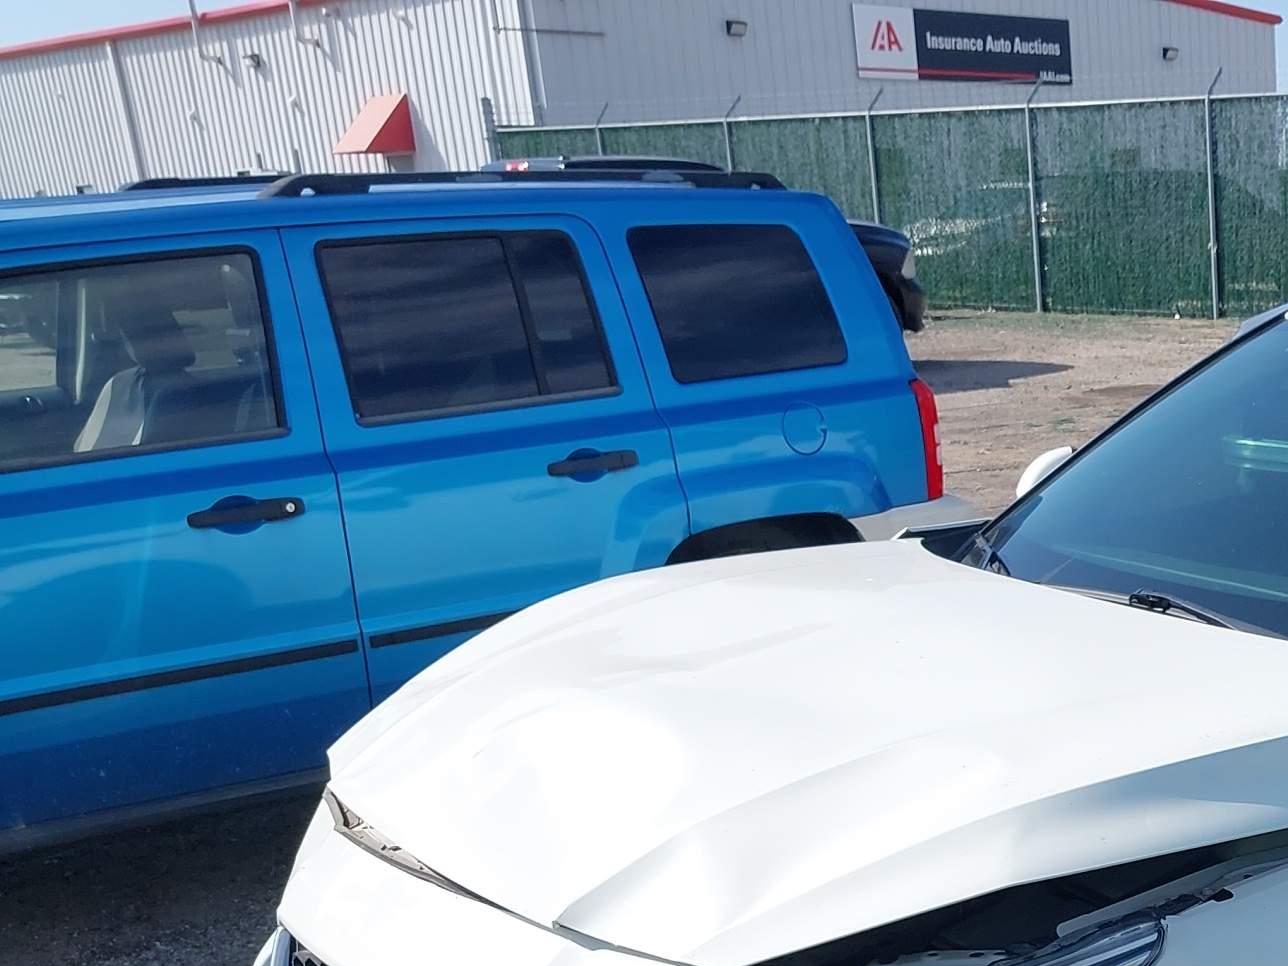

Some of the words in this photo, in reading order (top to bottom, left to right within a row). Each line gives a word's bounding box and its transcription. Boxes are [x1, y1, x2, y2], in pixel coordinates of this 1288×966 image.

[926, 31, 984, 52] Insurance
[986, 35, 1011, 53] Auto
[1013, 36, 1061, 57] Auctions
